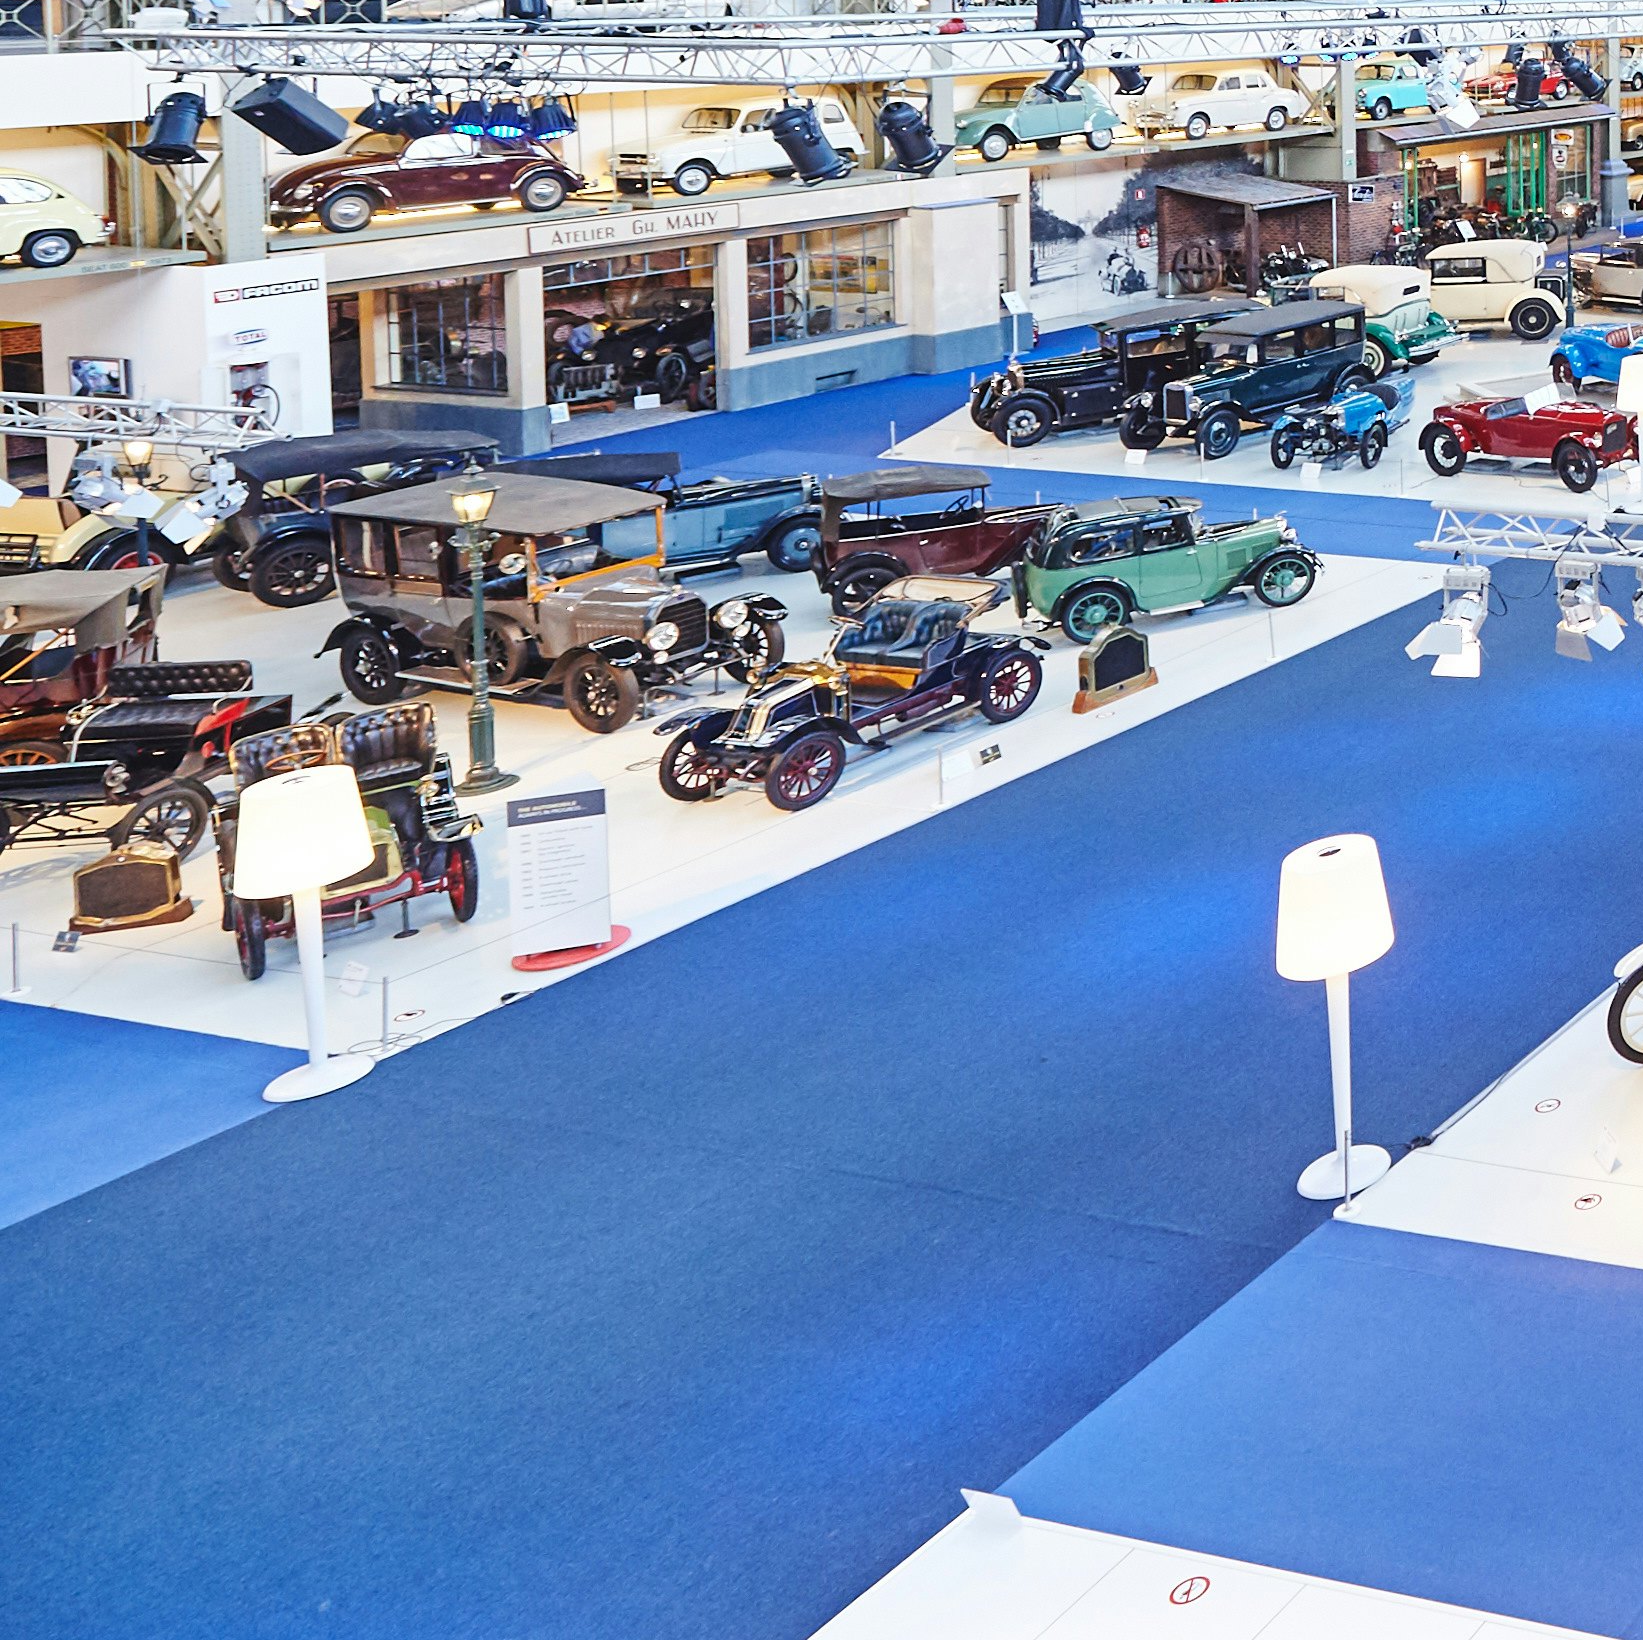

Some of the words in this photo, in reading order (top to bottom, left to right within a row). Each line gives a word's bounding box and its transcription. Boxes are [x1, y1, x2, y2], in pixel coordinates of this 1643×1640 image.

[666, 210, 719, 231] MAHY
[243, 279, 318, 299] FACOM
[234, 331, 267, 342] TOTAL
